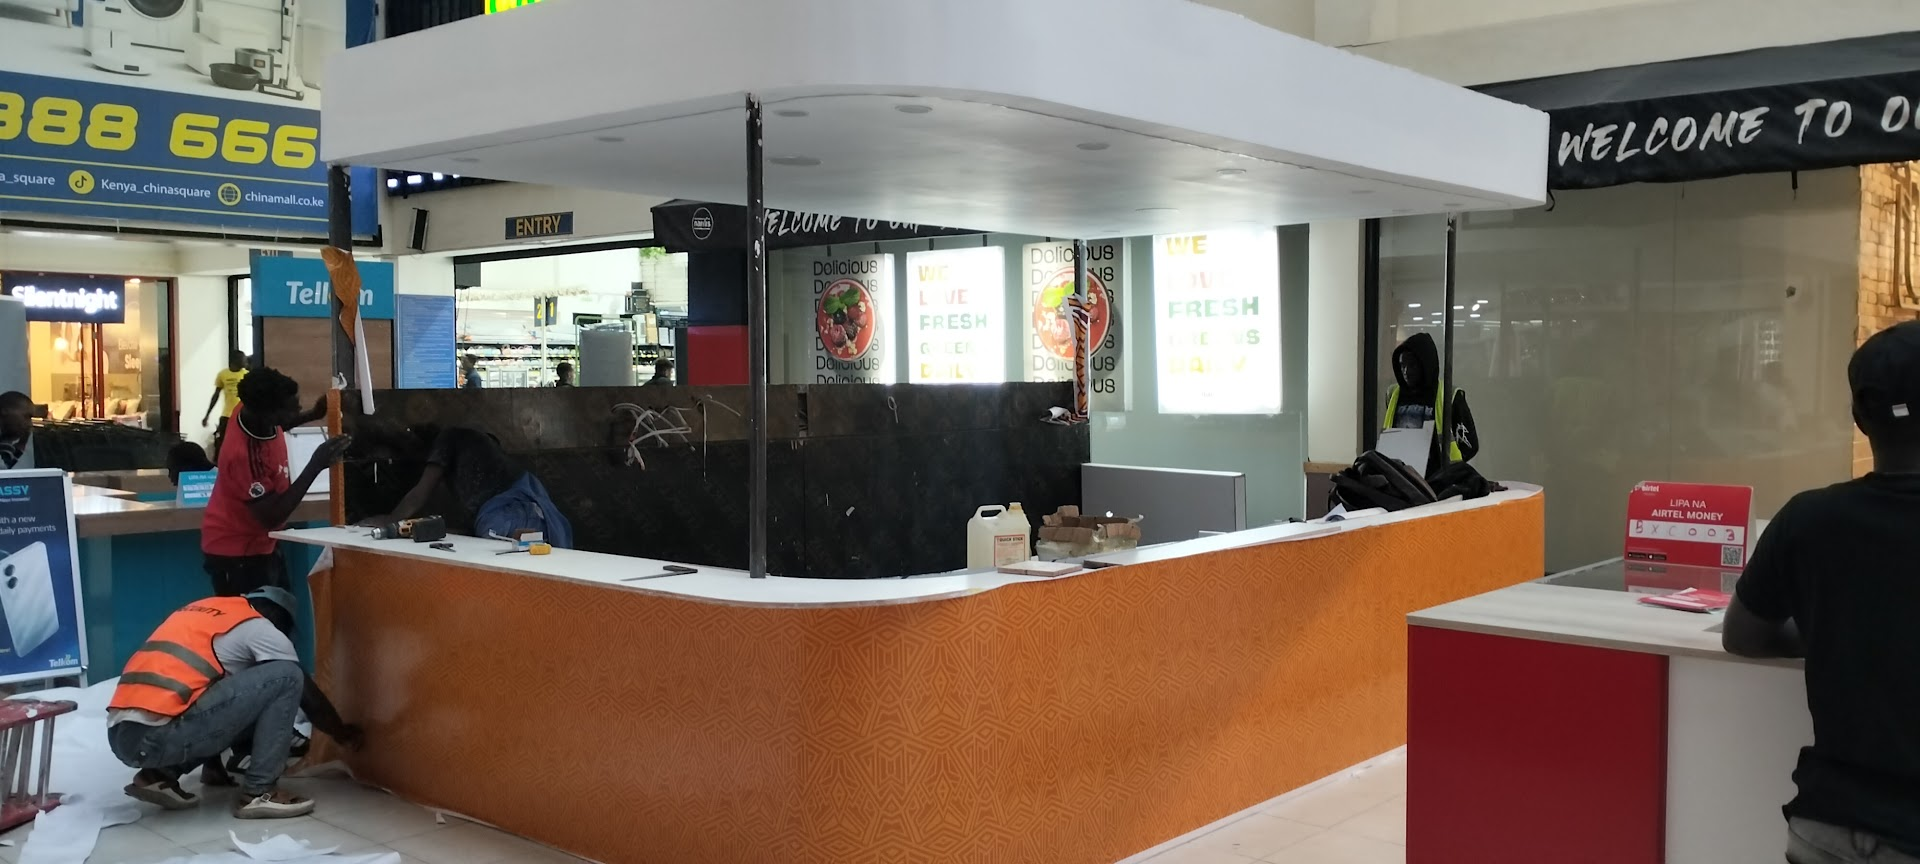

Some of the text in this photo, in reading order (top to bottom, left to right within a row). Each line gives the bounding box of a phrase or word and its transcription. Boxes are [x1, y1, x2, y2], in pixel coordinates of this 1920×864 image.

[1558, 96, 1920, 166] WELCOME TO O
[169, 113, 318, 168] 666
[101, 179, 211, 198] Kenya_chinasquare
[245, 192, 324, 207] chinamall.co.ke
[516, 215, 561, 237] ENTRY
[1166, 234, 1208, 255] WE
[918, 264, 949, 282] WE
[12, 285, 118, 314] Silentnight
[286, 281, 374, 306] Telm
[919, 288, 969, 305] LVE
[1169, 296, 1259, 319] FRESH
[919, 313, 988, 330] FRESH
[1670, 499, 1707, 508] LIPA NA
[1651, 509, 1723, 521] AIRTEL MONEY
[18, 525, 57, 535] payments
[49, 656, 79, 668] Telkom
